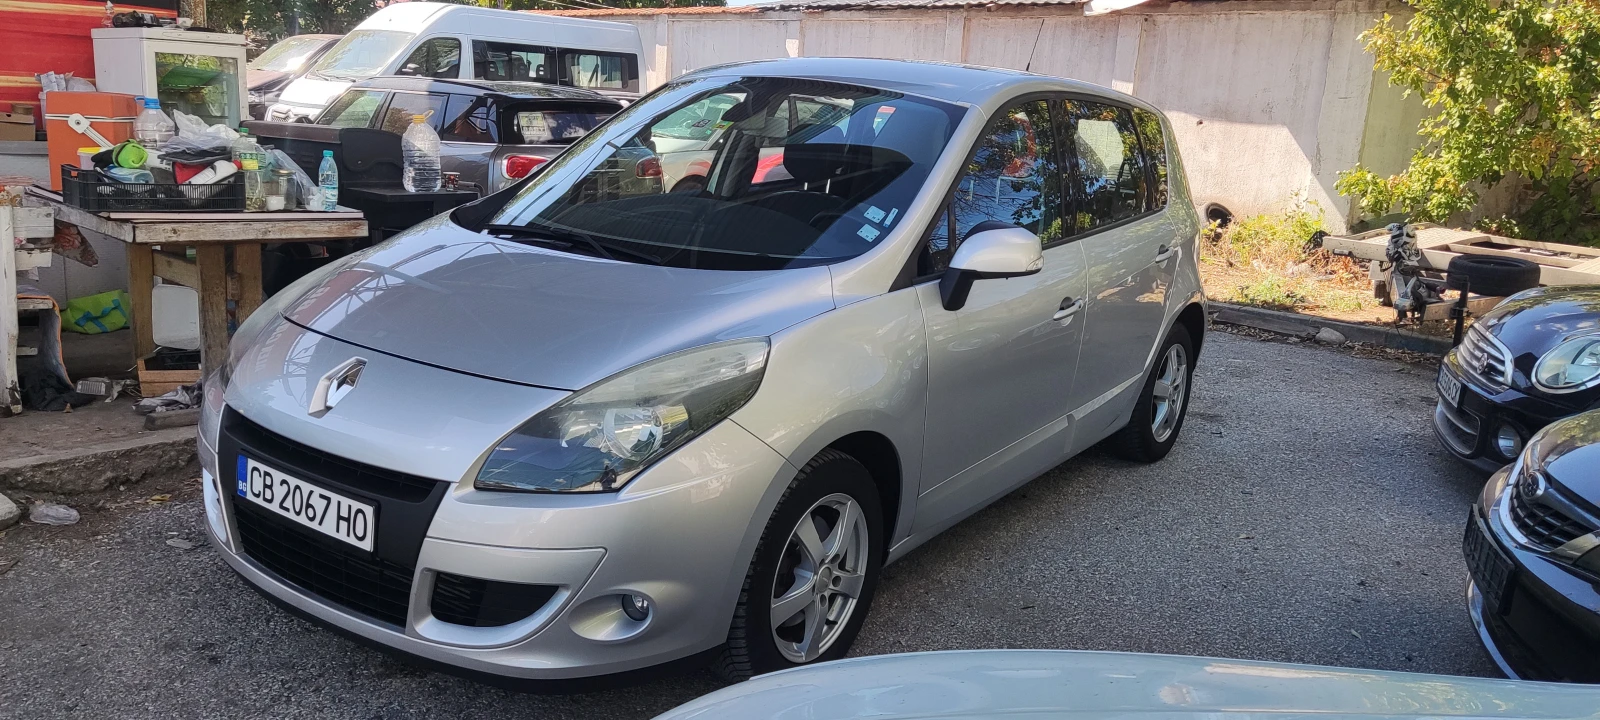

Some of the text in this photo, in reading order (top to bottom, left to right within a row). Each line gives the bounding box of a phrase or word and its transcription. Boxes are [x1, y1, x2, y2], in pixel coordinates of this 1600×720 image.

[238, 480, 247, 492] BG
[250, 466, 367, 542] CB 2067 HO
